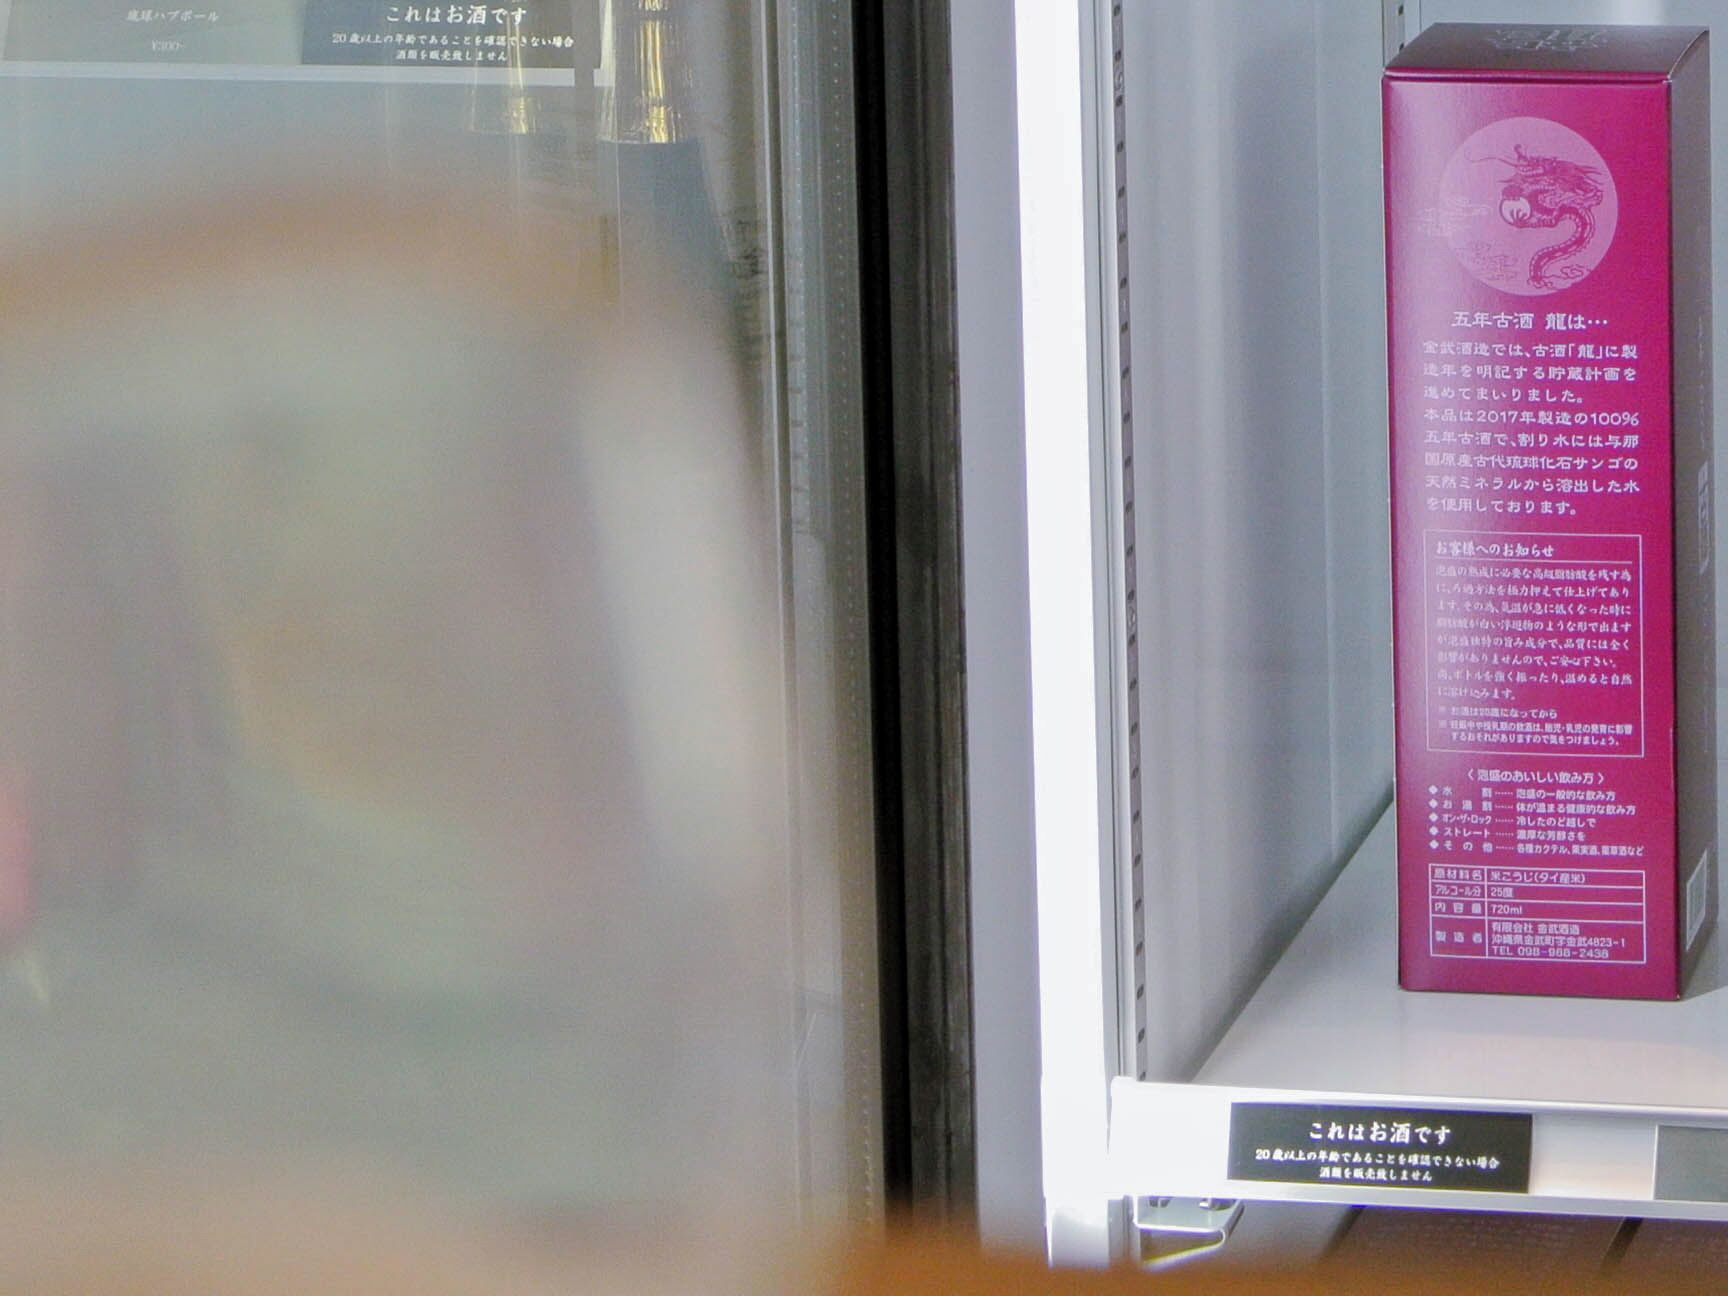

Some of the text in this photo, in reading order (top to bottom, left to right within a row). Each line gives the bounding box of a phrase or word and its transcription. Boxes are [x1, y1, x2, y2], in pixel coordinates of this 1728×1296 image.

[386, 5, 528, 25] これはお酒です
[1451, 312, 1534, 329] 五年古酒
[1423, 366, 1637, 382] 造年を明記する貯蔵計画を
[1423, 385, 1583, 404] 進めてまいりました。
[1424, 430, 1639, 449] 五年古酒で、割り水には与那
[1427, 498, 1577, 515] を使用しております。
[1436, 541, 1554, 557] お客様へのお知らせ
[1443, 828, 1491, 838] ストレート
[1491, 904, 1522, 914] 720ml
[1492, 921, 1534, 934] 有限会社
[1492, 945, 1514, 956] TEL
[1309, 1121, 1451, 1145] これはお酒です
